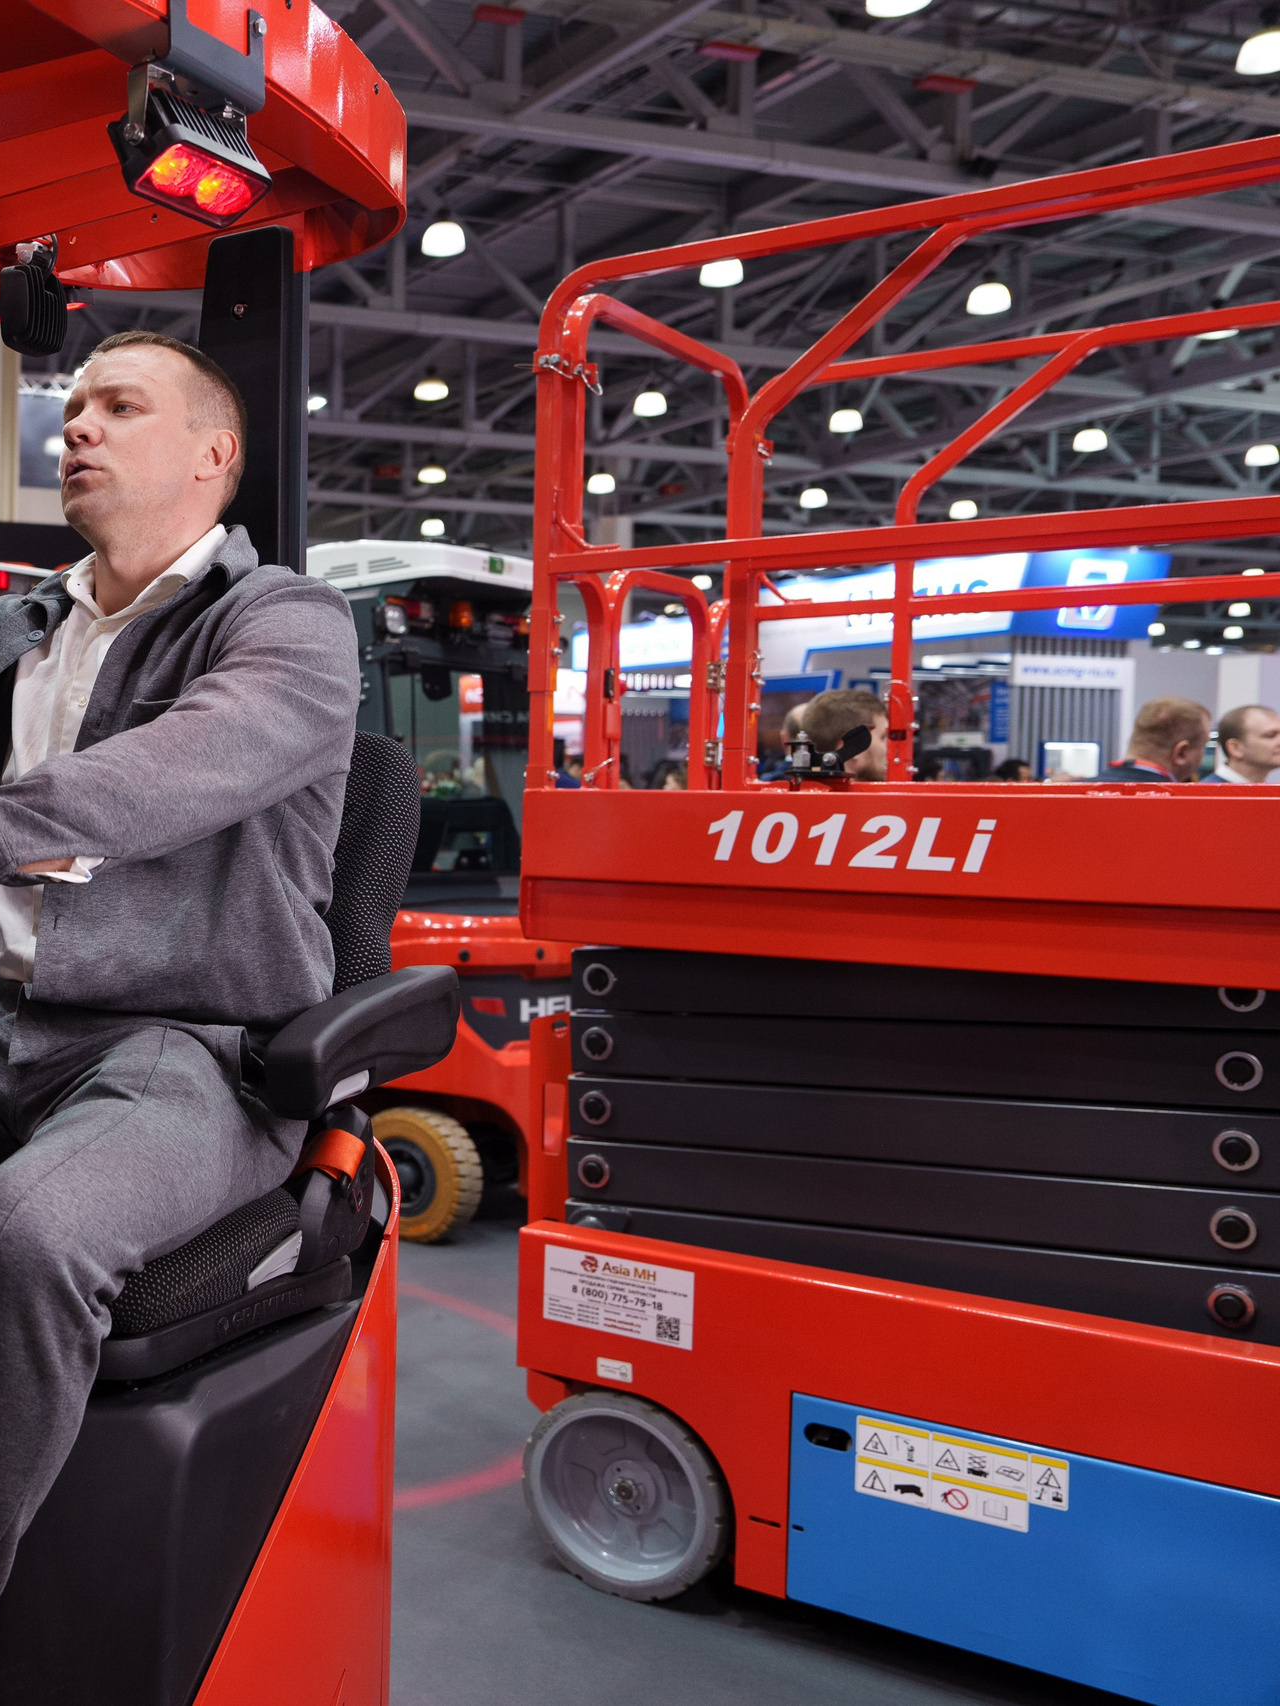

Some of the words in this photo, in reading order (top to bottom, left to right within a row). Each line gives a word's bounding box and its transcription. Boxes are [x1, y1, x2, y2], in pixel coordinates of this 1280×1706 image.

[707, 810, 997, 873] 1012Li
[602, 1261, 631, 1277] Asia
[633, 1267, 657, 1282] MH
[572, 1285, 578, 1293] 8
[581, 1286, 609, 1301] (800)
[612, 1293, 663, 1311] 775-79-18
